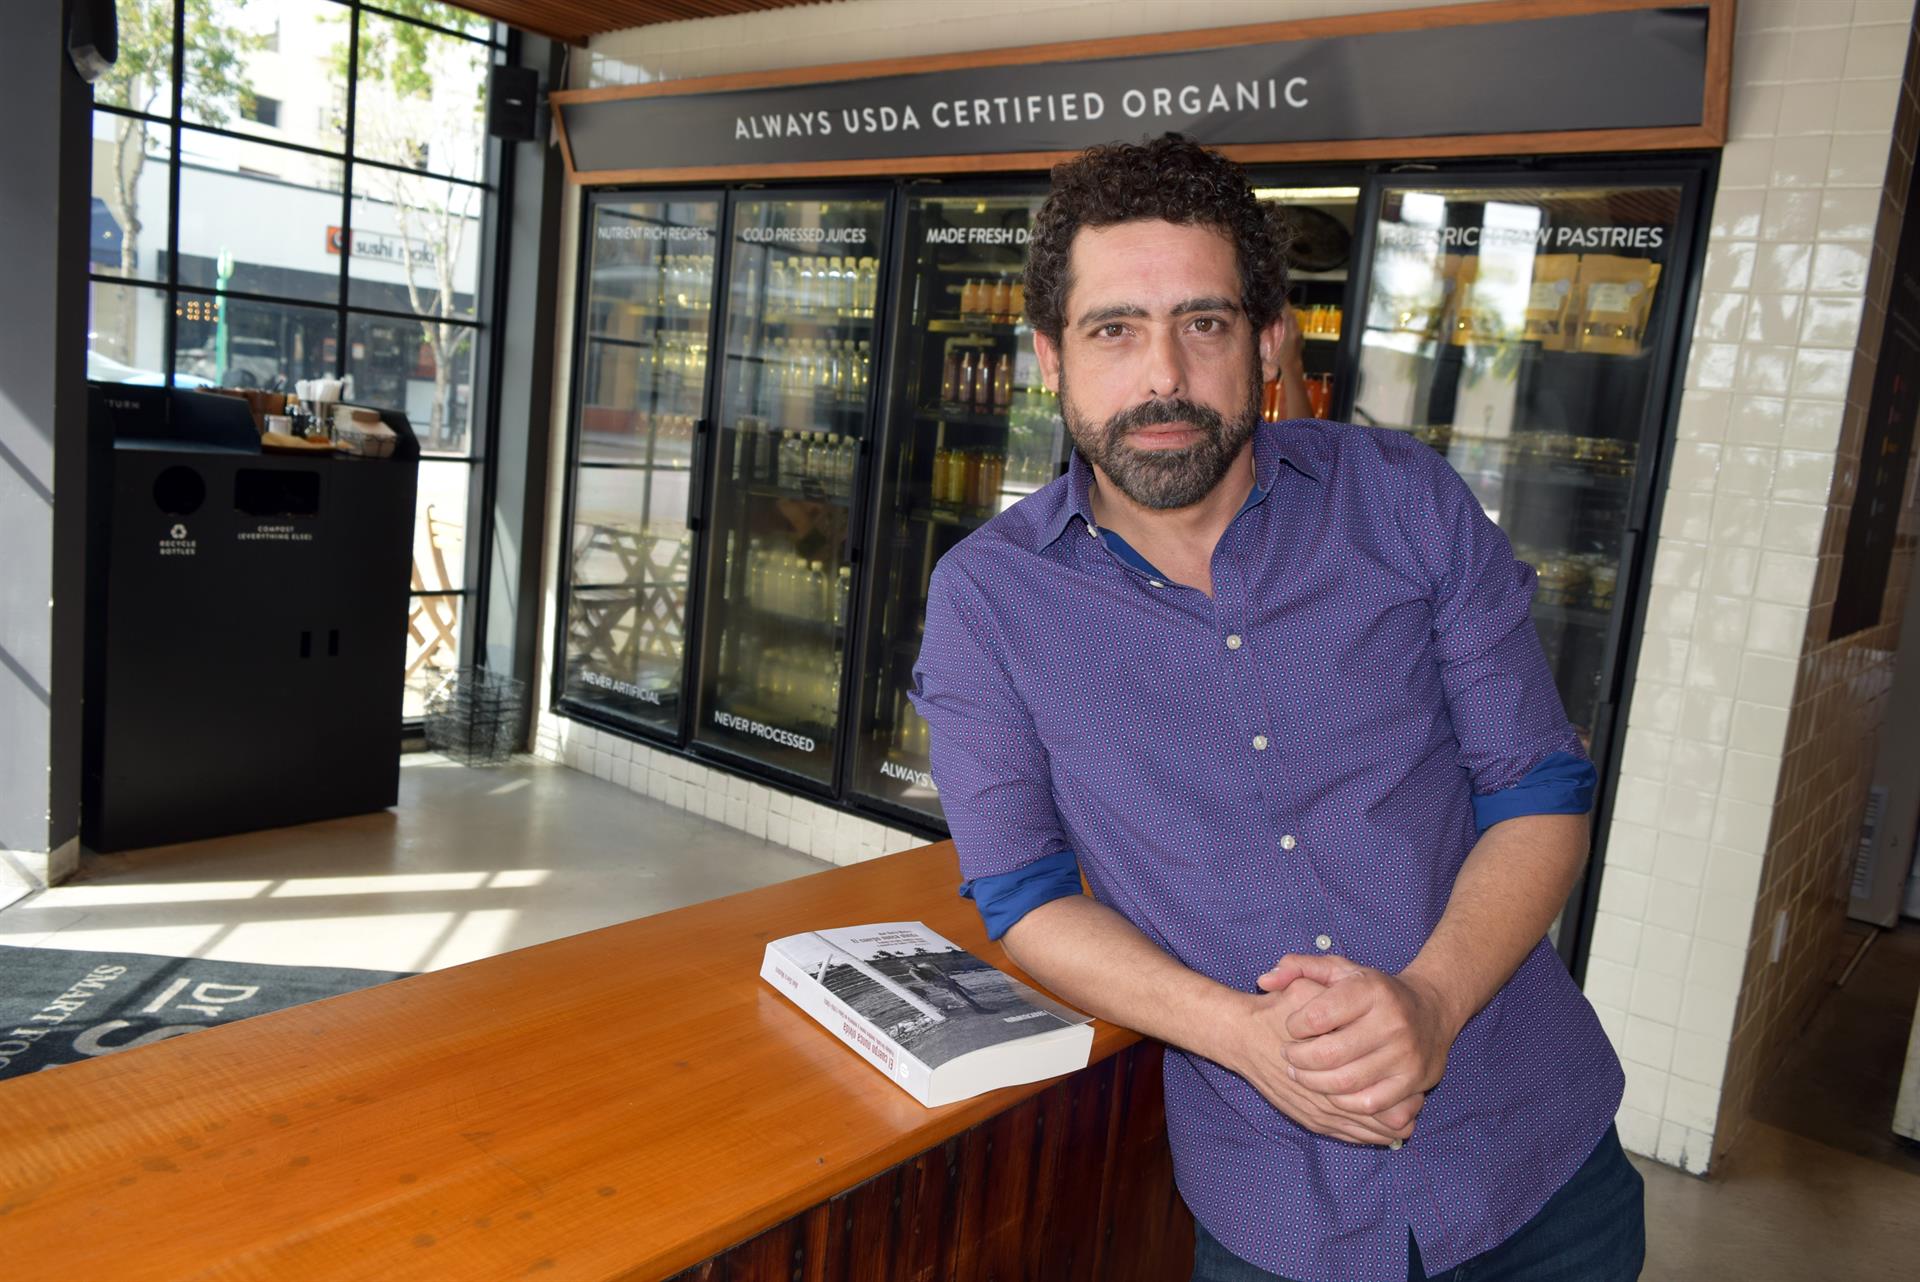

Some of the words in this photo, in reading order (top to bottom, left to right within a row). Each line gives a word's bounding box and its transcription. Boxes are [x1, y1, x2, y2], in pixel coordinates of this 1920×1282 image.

[735, 111, 832, 139] ALWAYS
[843, 105, 920, 133] USDA
[932, 92, 1105, 128] CERTIFIED
[1122, 77, 1309, 118] ORGANIC
[598, 226, 643, 241] NUTRIENT
[643, 226, 668, 241] RICH
[669, 226, 709, 241] RECIPES
[743, 228, 774, 242] COLD
[775, 228, 825, 243] PRESSED
[825, 228, 867, 244] JUICES
[926, 228, 966, 243] MADE
[968, 228, 1013, 244] FRESH
[1556, 227, 1663, 247] PASTRIES
[355, 235, 393, 257] sushi
[257, 525, 294, 533] COMPOST
[159, 540, 196, 548] RECYCLE
[160, 548, 196, 556] BOTTLES
[582, 668, 612, 690] NEVER
[612, 681, 660, 706] ARTIFICIAL
[714, 710, 749, 733] NEVER
[750, 721, 815, 752] PROCESSED
[880, 761, 929, 788] ALWAYS
[30, 965, 127, 1025] SMART
[0, 1027, 50, 1069] FO
